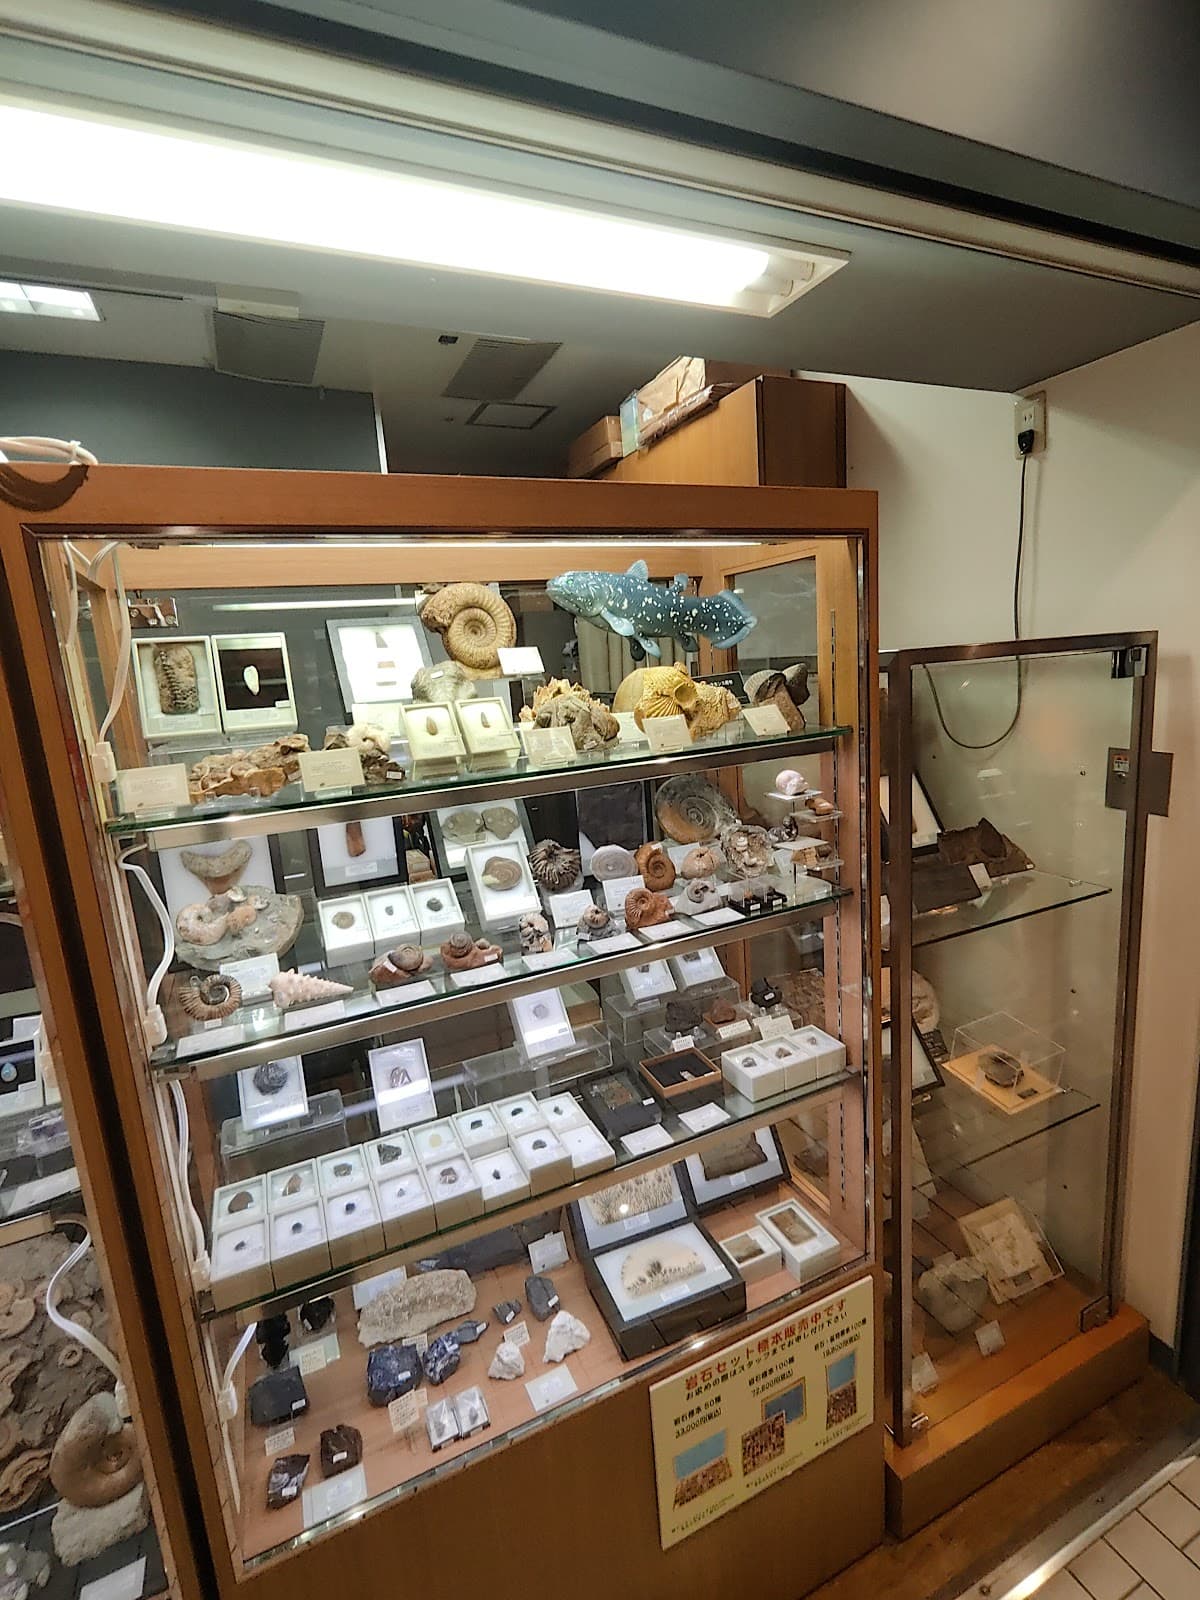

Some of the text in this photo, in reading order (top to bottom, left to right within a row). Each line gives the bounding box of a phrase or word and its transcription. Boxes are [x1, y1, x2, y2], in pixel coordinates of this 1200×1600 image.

[685, 1298, 846, 1390] 岩石セット標本販売中です
